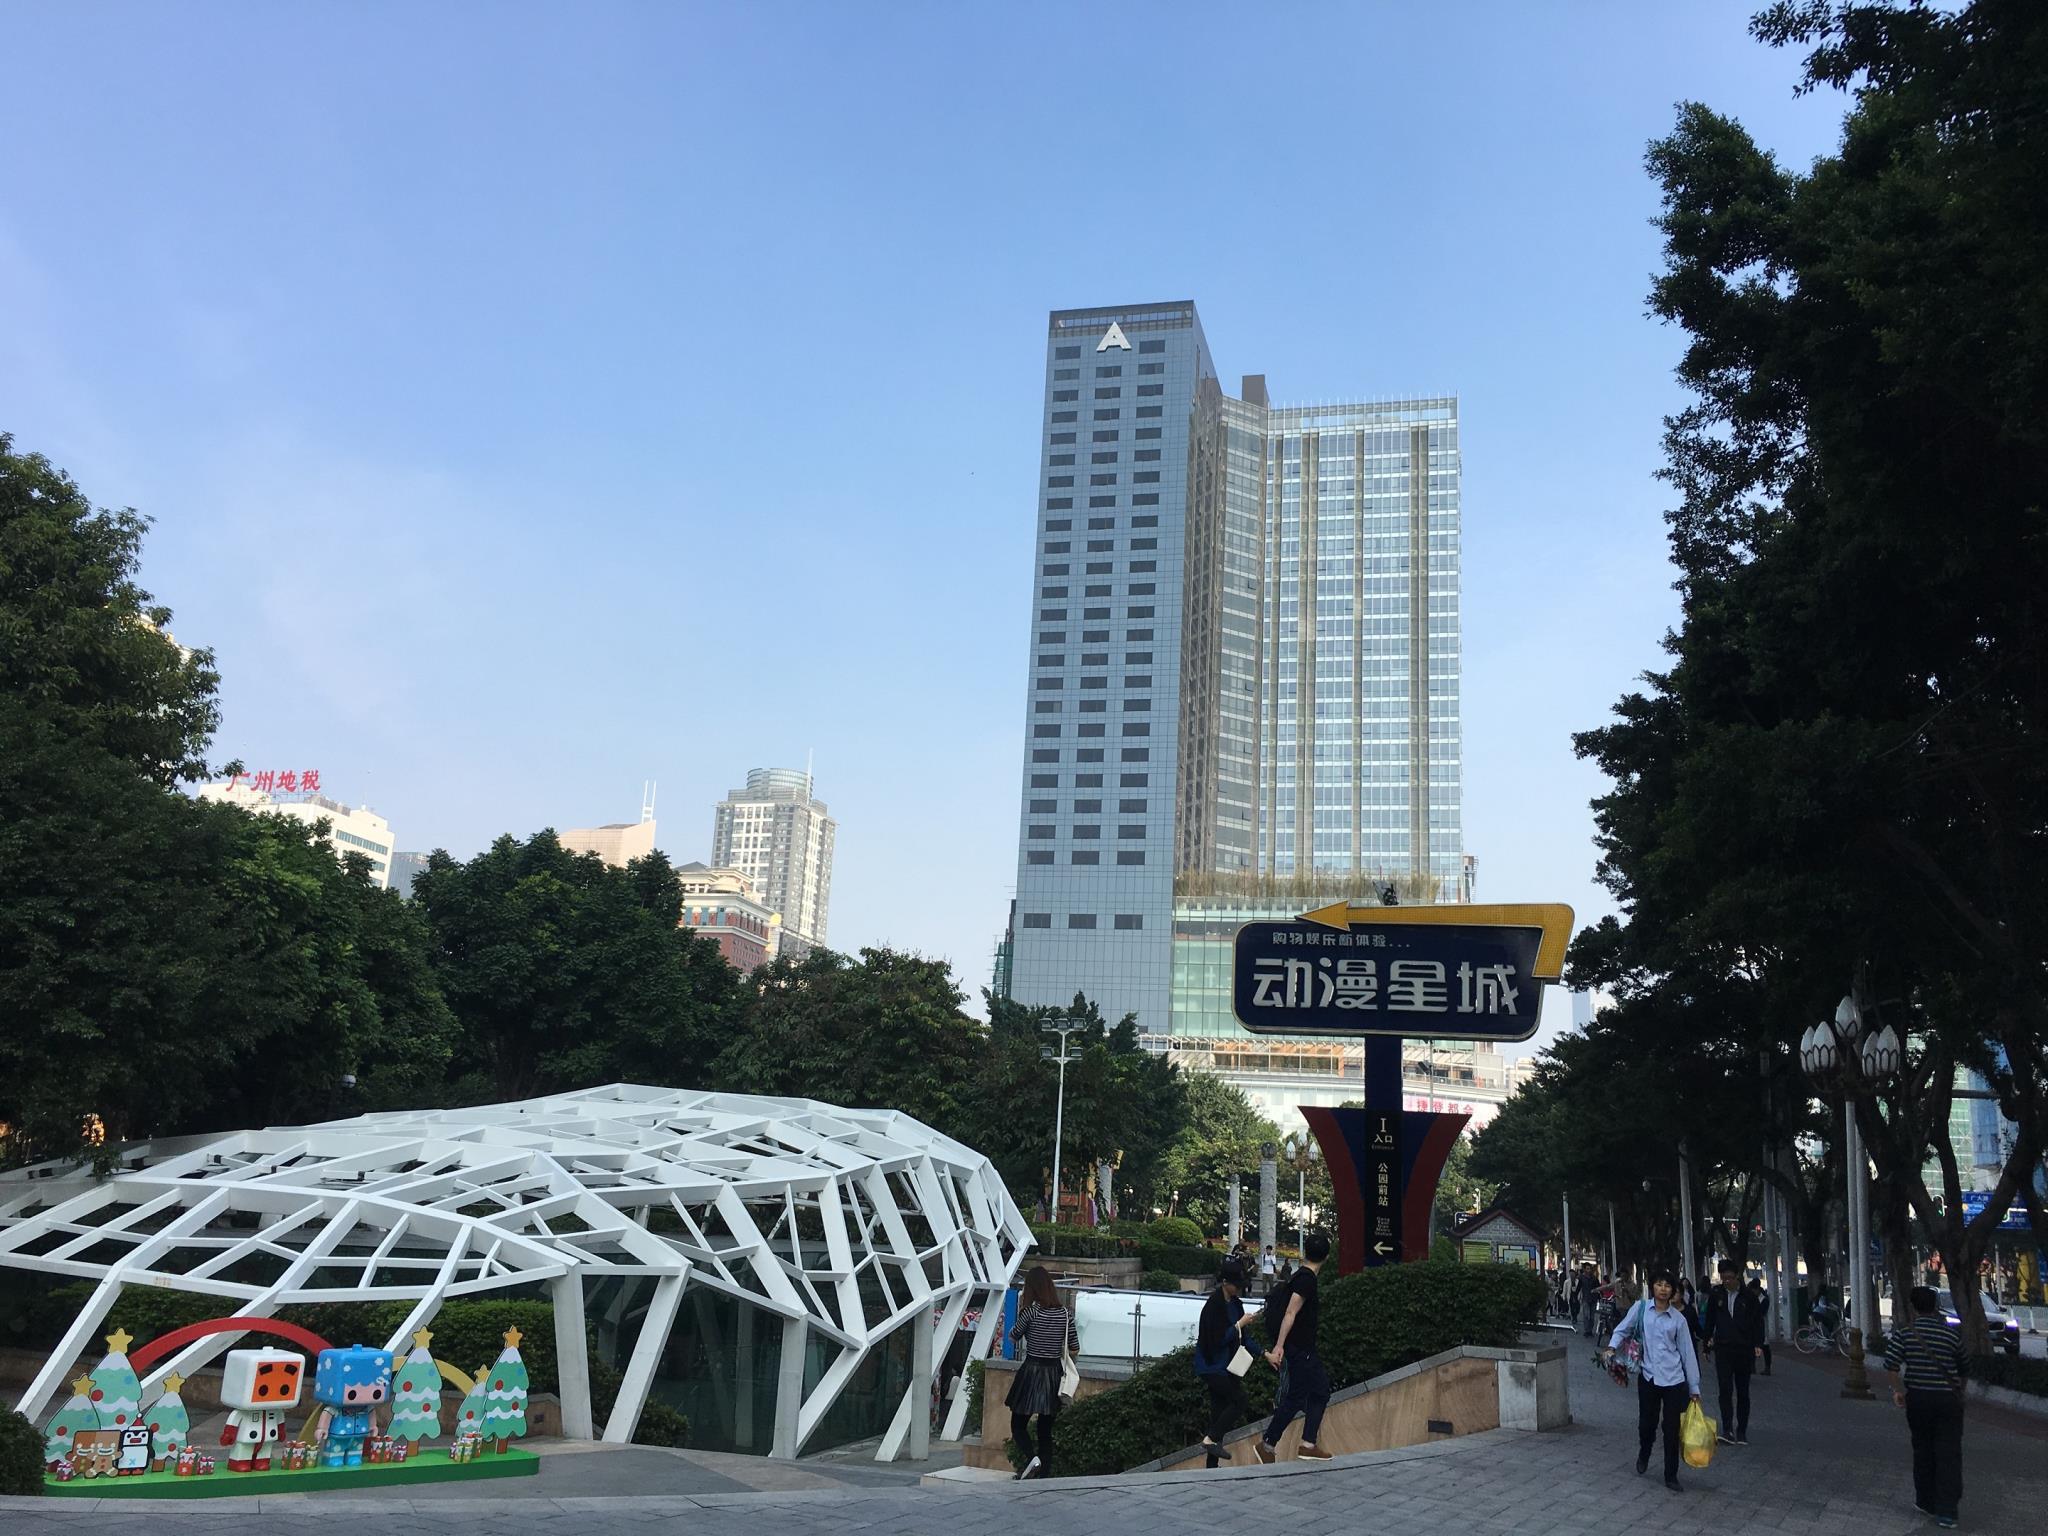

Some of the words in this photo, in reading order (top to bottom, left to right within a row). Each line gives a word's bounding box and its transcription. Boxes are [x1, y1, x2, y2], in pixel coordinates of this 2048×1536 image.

[226, 770, 321, 792] 广州地税
[1252, 957, 1519, 1016] 动漫星城
[1374, 1134, 1393, 1144] 入口
[1378, 1162, 1389, 1207] 公园前站
